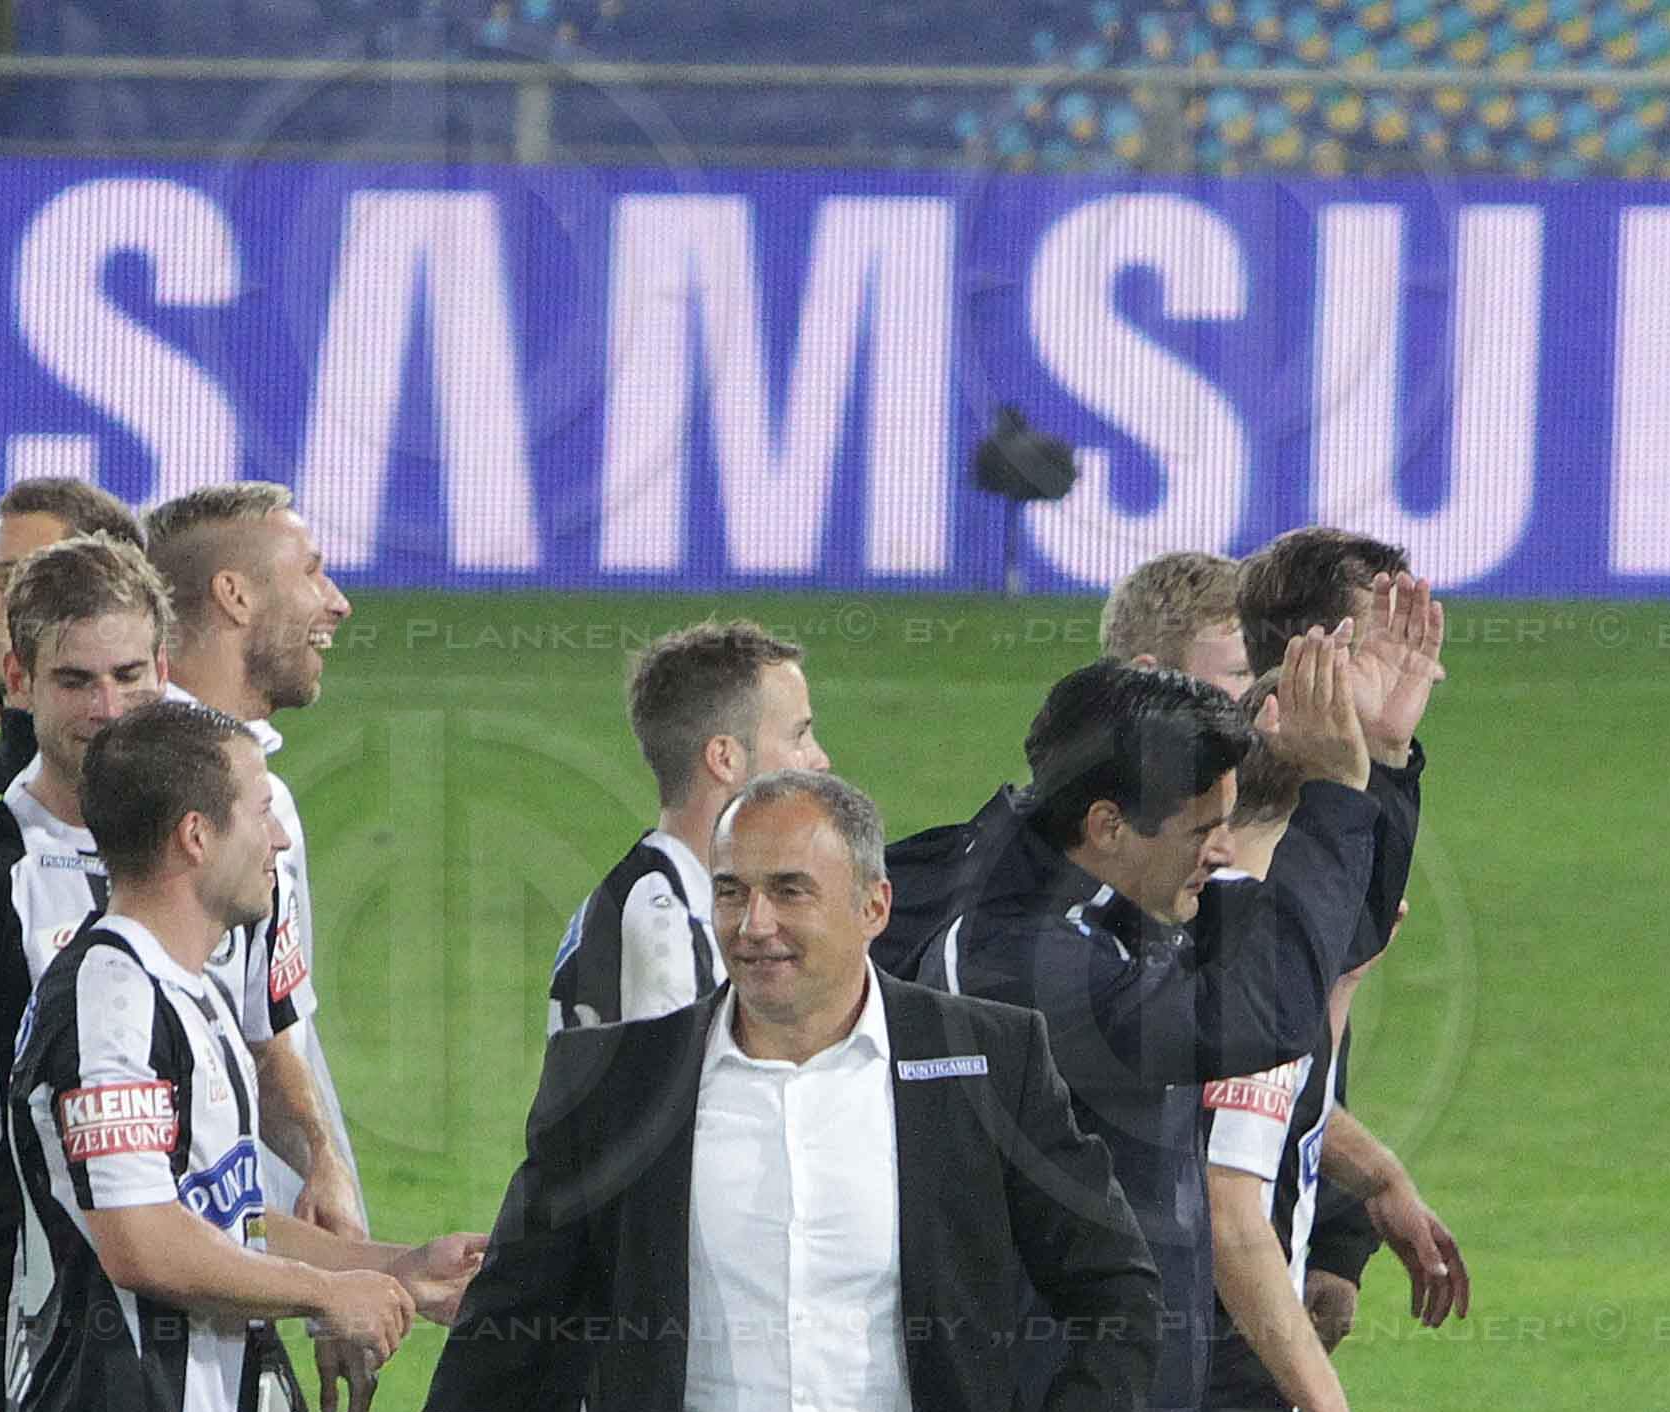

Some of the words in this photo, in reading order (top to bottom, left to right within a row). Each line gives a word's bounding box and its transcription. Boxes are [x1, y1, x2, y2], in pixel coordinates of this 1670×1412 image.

[903, 1060, 981, 1078] PUNTIGAMER
[65, 1087, 173, 1128] KLEINE
[71, 1123, 173, 1155] ZEITUNG
